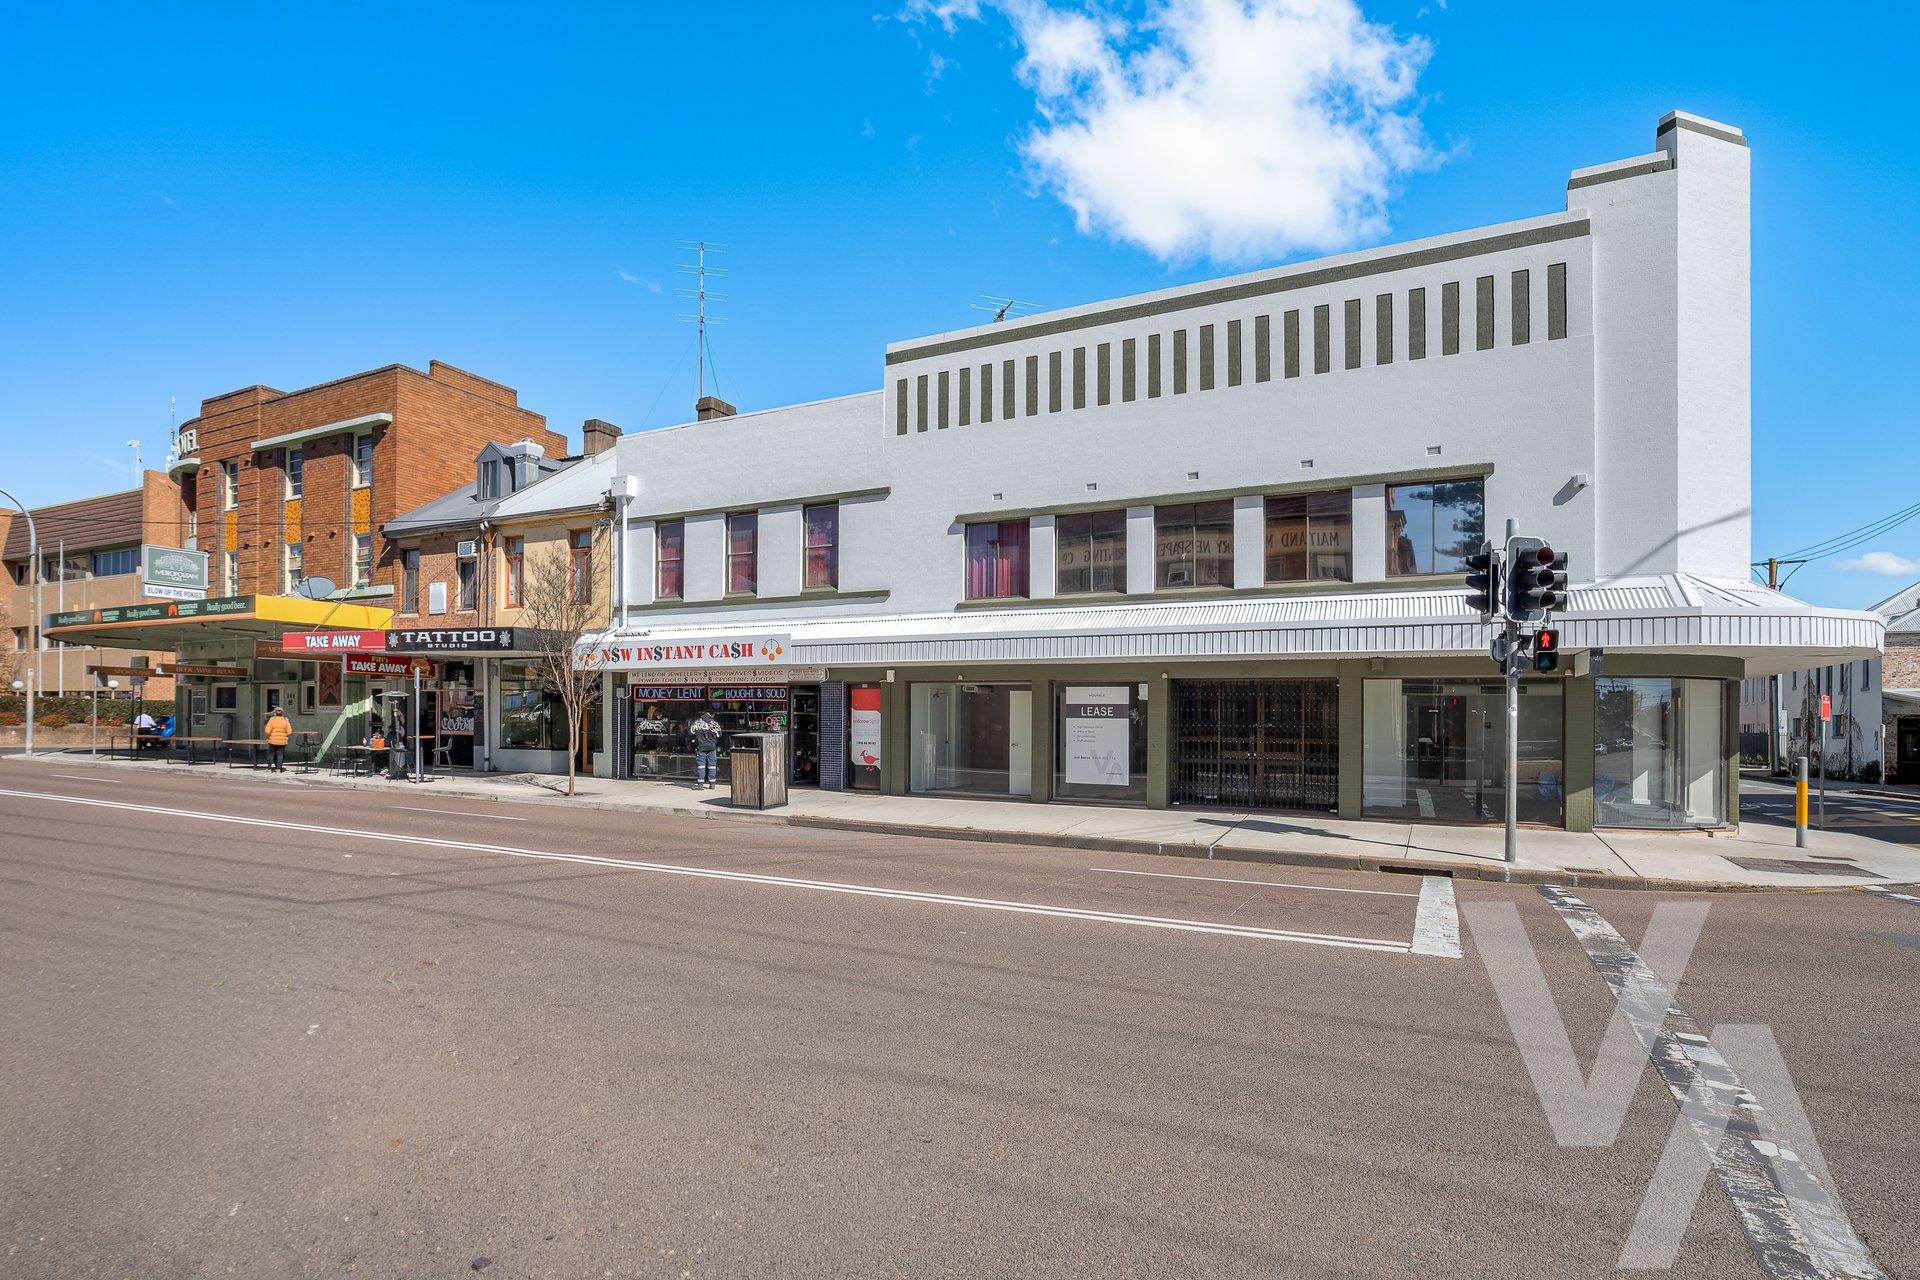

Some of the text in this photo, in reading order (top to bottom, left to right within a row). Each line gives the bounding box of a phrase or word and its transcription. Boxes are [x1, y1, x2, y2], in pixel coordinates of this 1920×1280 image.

[147, 586, 163, 594] BLOW
[174, 589, 183, 597] THE
[221, 602, 234, 611] good
[305, 635, 361, 648] TAKE AWAY
[401, 631, 496, 643] TATTOO
[350, 661, 407, 673] TAKE AWAY
[638, 688, 702, 698] MONEY LENT
[725, 688, 755, 699] BOUGHT
[757, 689, 762, 698] &
[765, 688, 786, 699] SOLD
[1081, 706, 1114, 716] LEASE
[765, 716, 787, 726] OPEN
